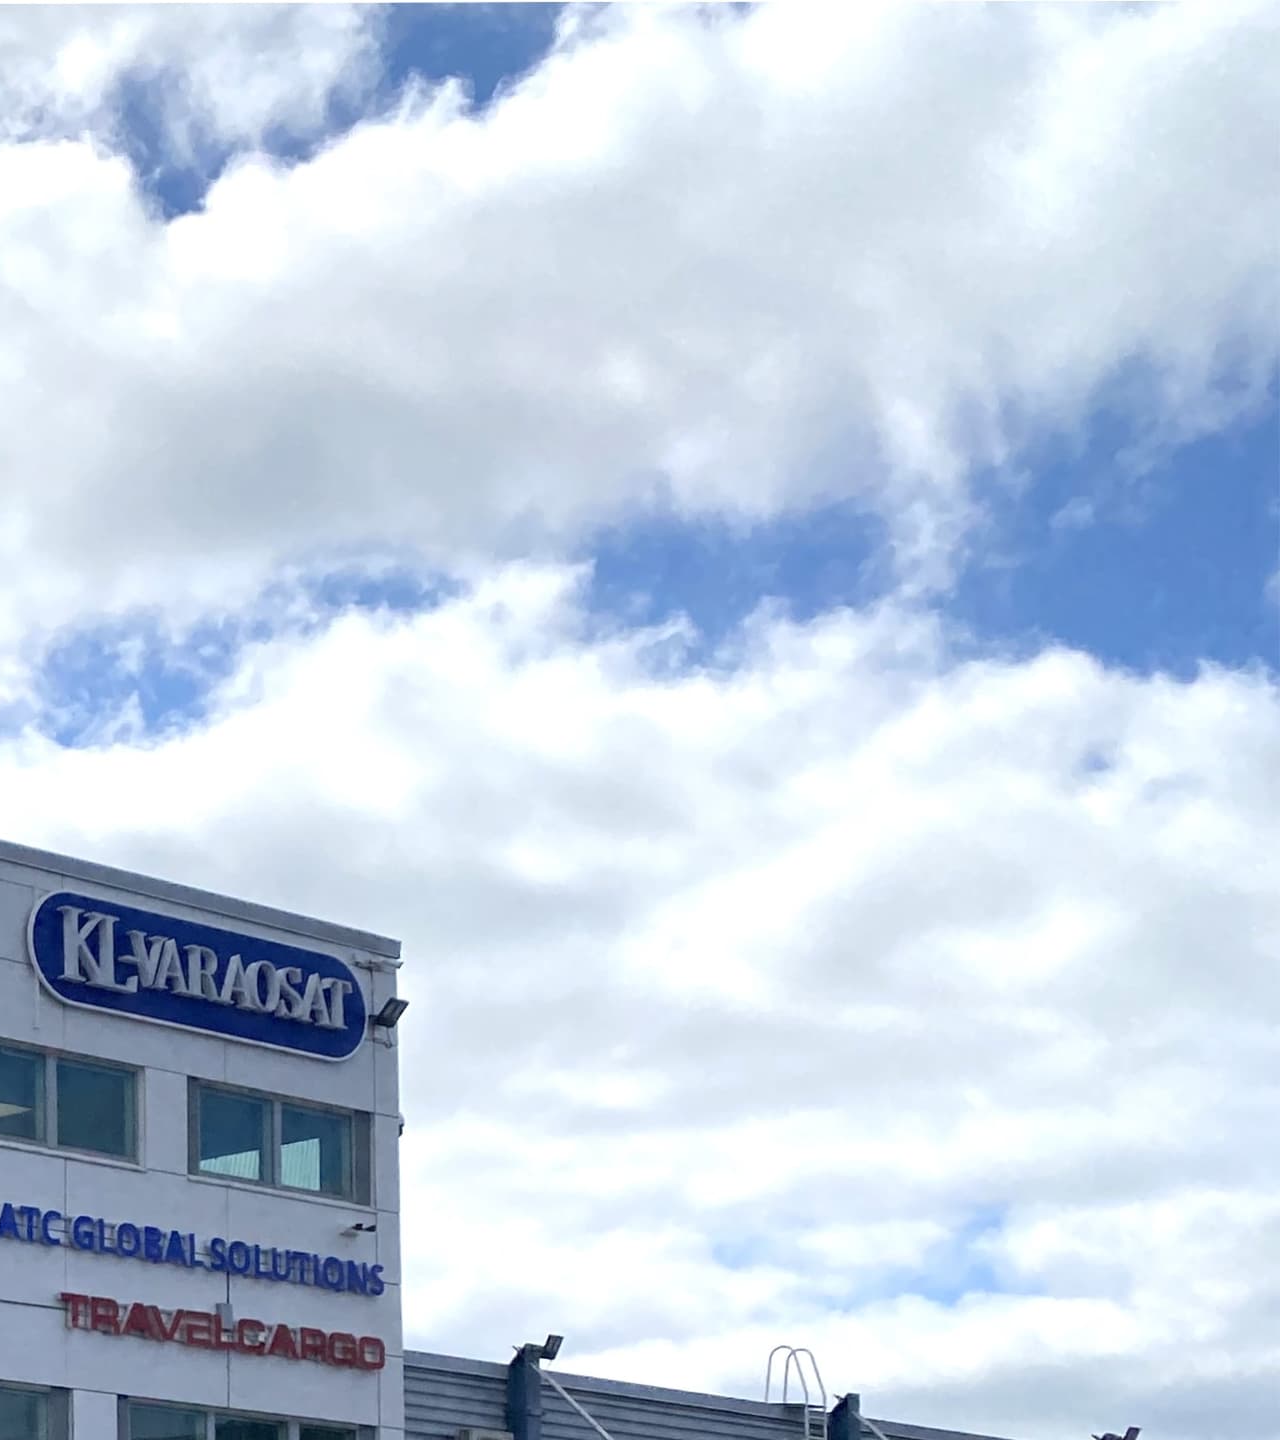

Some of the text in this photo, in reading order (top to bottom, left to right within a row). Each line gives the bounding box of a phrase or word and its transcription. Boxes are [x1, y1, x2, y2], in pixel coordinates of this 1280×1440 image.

[56, 905, 354, 1030] KL-VARAOSAT
[72, 1215, 204, 1269] GLOBAL
[209, 1237, 385, 1297] SOLUTIONS
[58, 1292, 386, 1371] TRAVELCARGO
